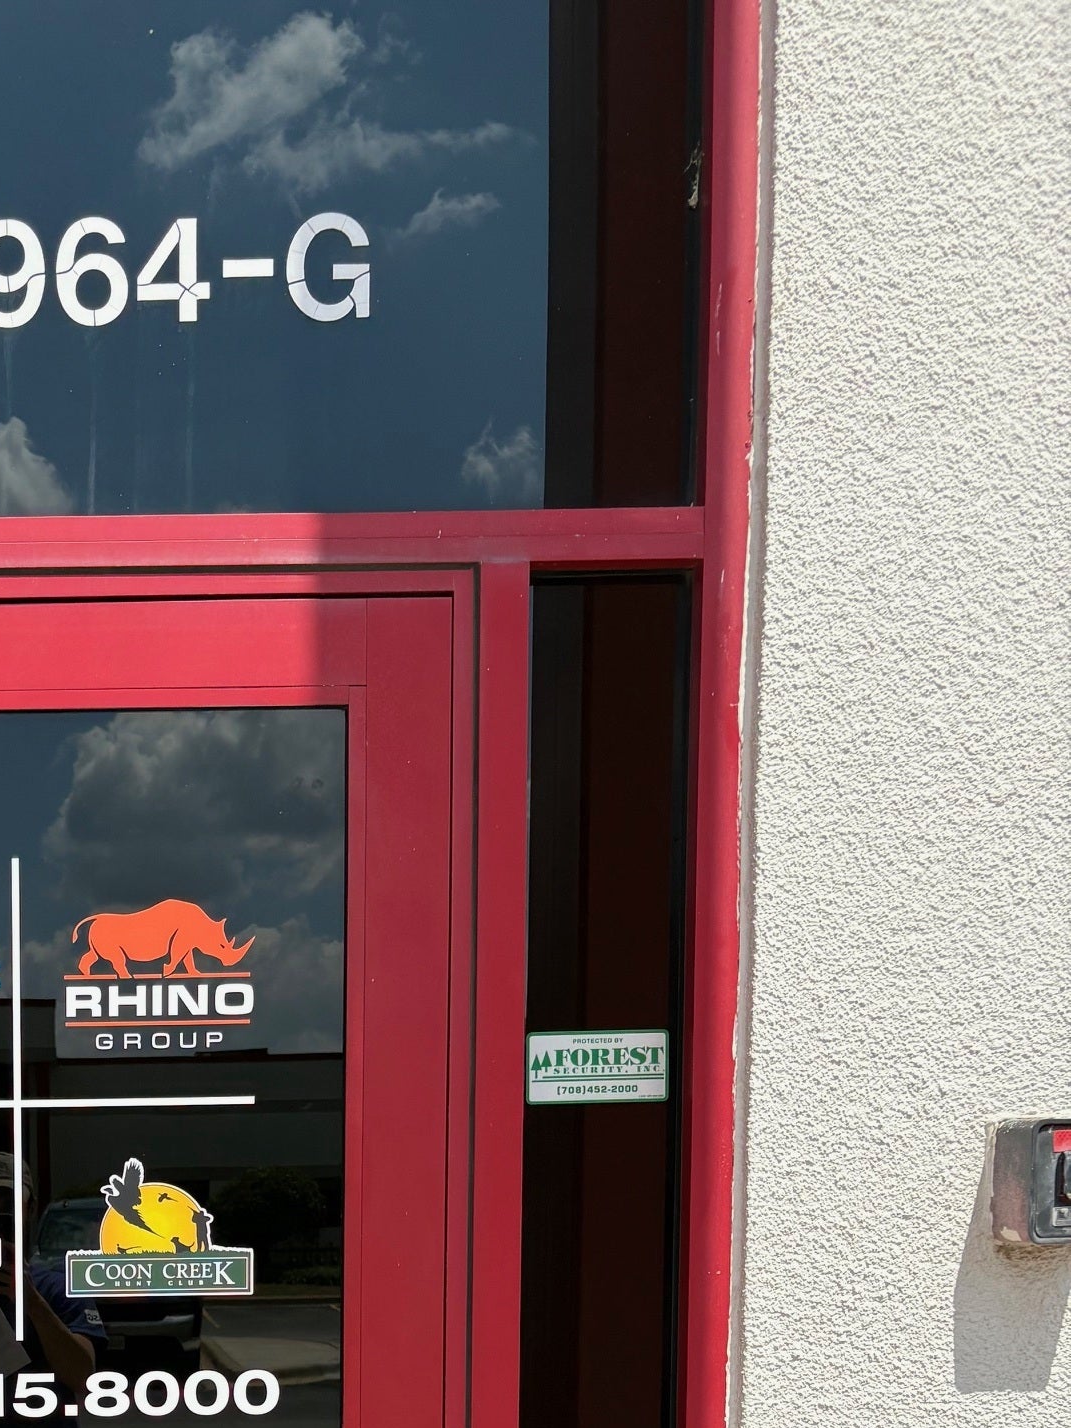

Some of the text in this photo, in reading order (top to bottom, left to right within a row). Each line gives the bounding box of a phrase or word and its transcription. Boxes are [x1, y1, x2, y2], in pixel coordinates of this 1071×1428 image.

[65, 983, 255, 1018] RHINO
[94, 1031, 223, 1050] GROUP
[572, 1037, 613, 1045] PROTECTED
[553, 1046, 665, 1067] FOREST
[556, 1084, 638, 1095] (708)452-2000
[84, 1261, 235, 1287] COON CREEK
